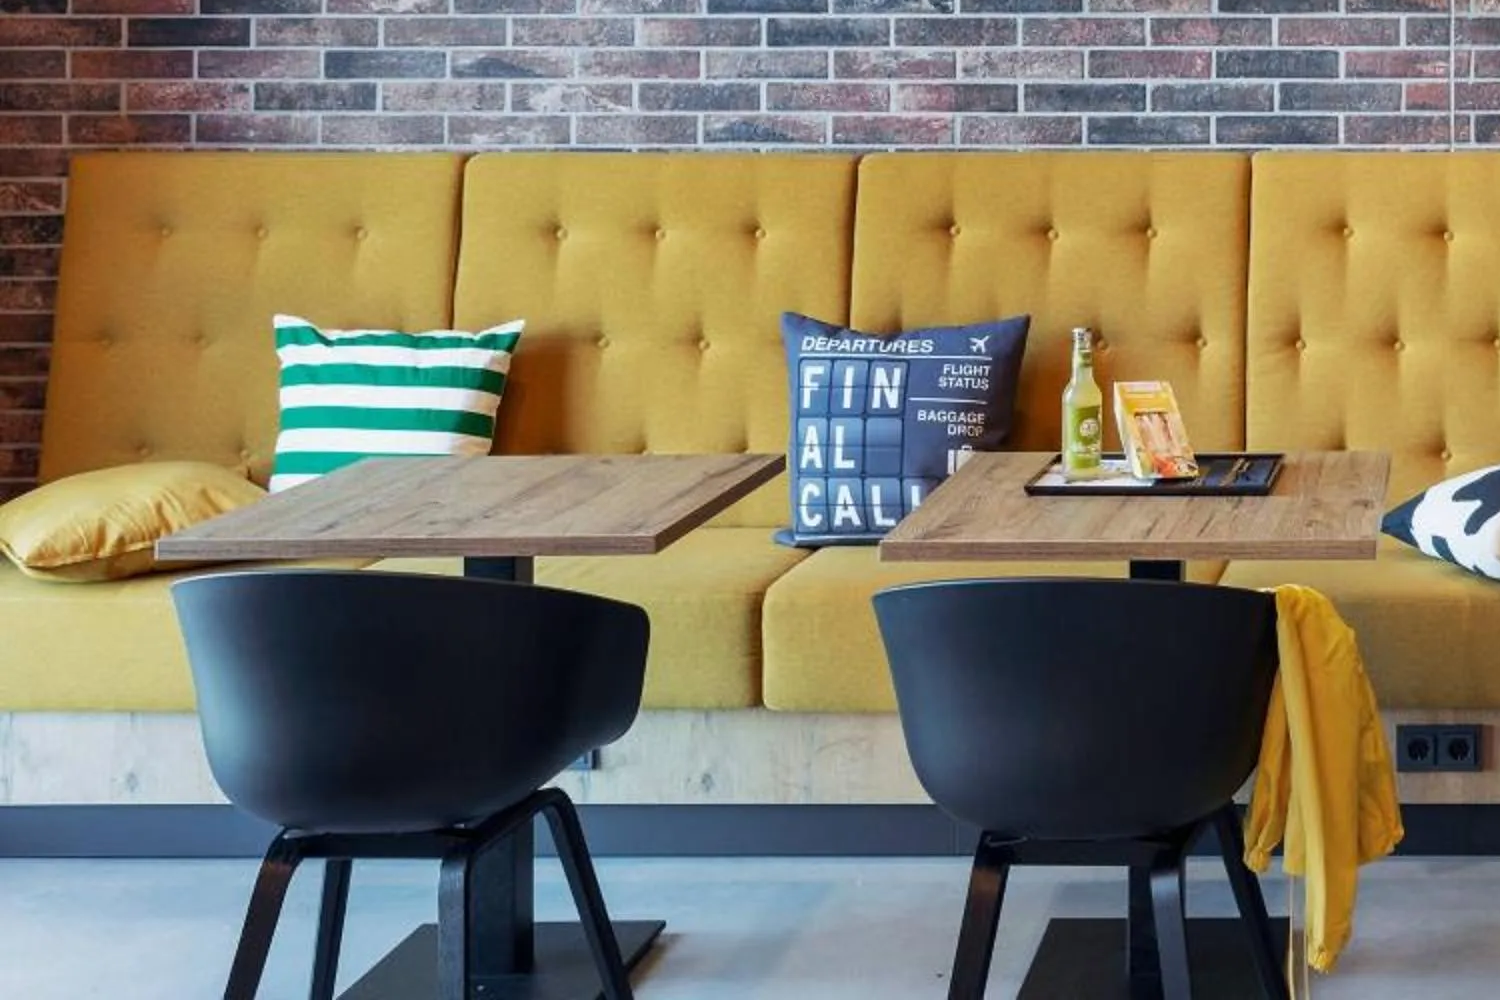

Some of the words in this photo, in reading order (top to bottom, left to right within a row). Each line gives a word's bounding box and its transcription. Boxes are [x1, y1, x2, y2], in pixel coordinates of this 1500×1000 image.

[801, 336, 934, 353] DEPARTURES
[943, 364, 991, 376] FLIGHT
[802, 365, 902, 409] FIN
[938, 376, 989, 390] STATUS
[917, 410, 985, 425] BAGGAGE
[947, 425, 983, 437] DROP
[800, 425, 856, 469] AL
